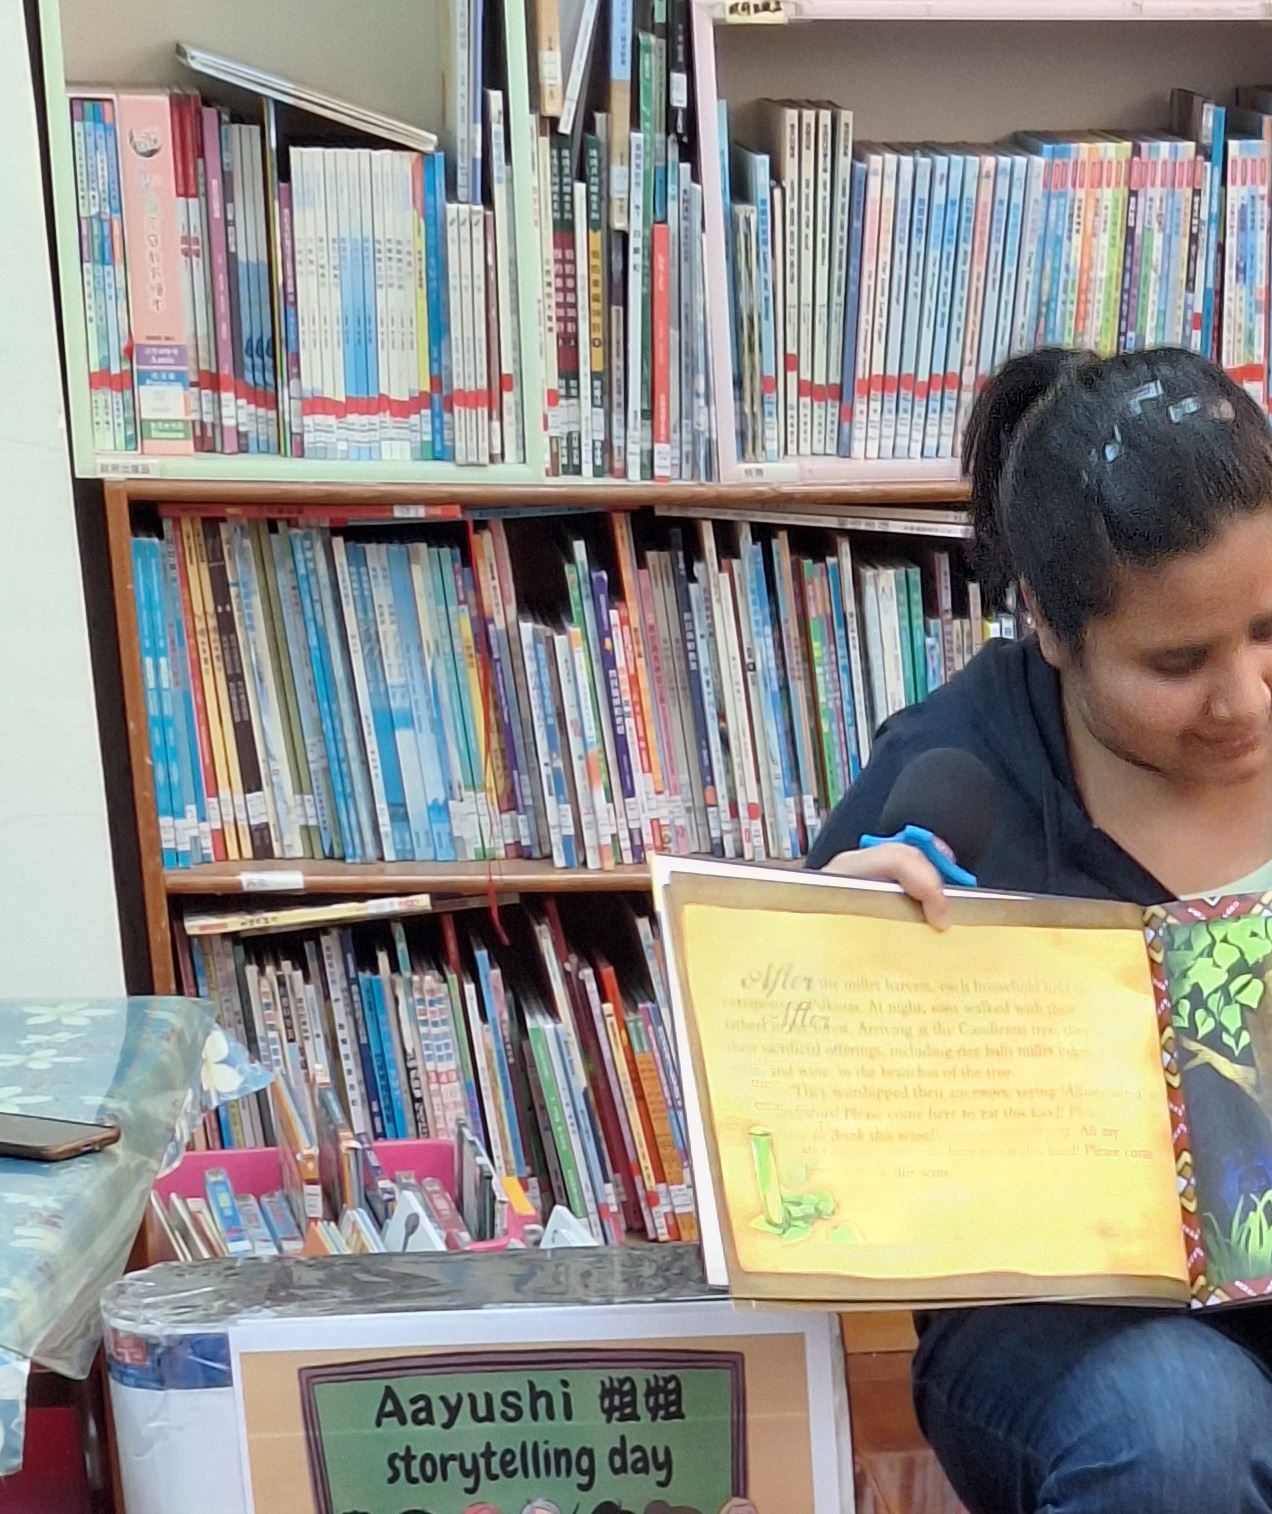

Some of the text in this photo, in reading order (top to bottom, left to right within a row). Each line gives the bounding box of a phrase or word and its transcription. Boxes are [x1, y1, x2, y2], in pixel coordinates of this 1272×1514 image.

[740, 961, 813, 998] After
[375, 1374, 685, 1429] Aayushi 姐姐
[387, 1434, 672, 1495] storytelling day
